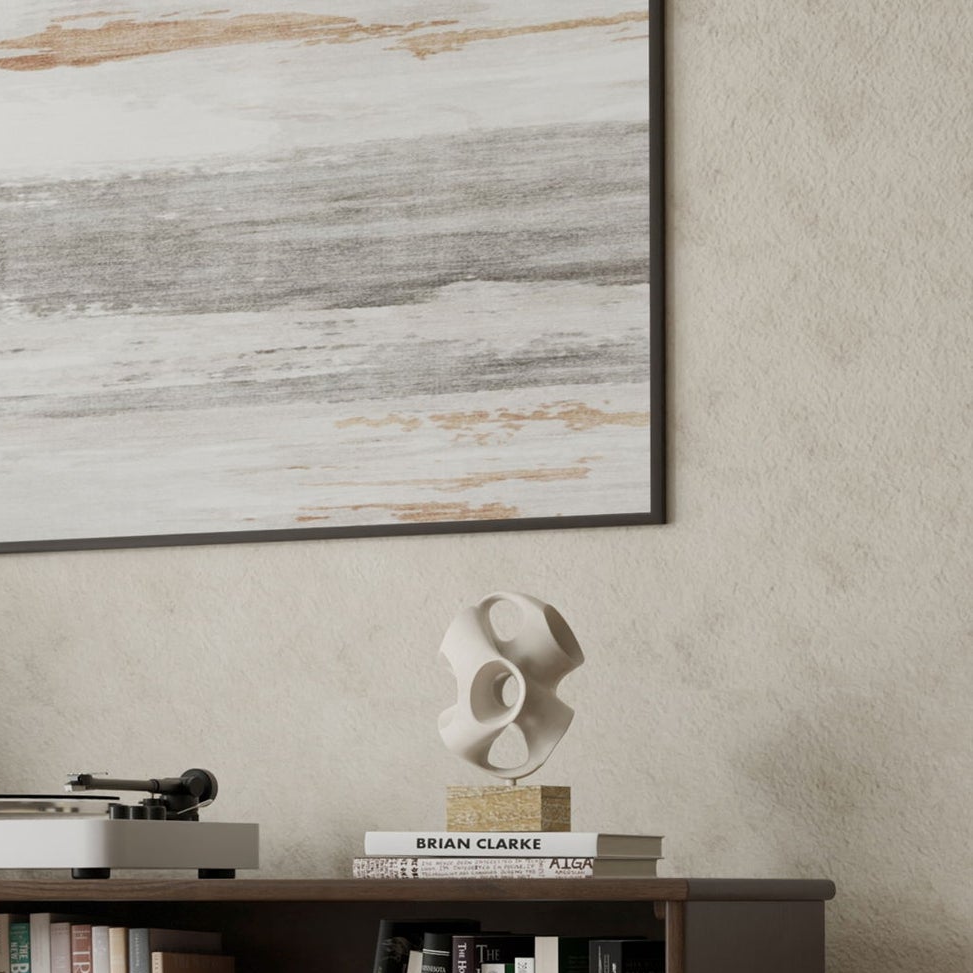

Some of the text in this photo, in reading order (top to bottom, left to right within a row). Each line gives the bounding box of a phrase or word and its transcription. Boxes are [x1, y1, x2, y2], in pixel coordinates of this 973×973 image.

[416, 838, 542, 850] BRIAN CLARKE
[549, 857, 593, 870] AIGA
[18, 943, 29, 960] THE
[457, 942, 467, 958] THE
[476, 944, 501, 963] THE
